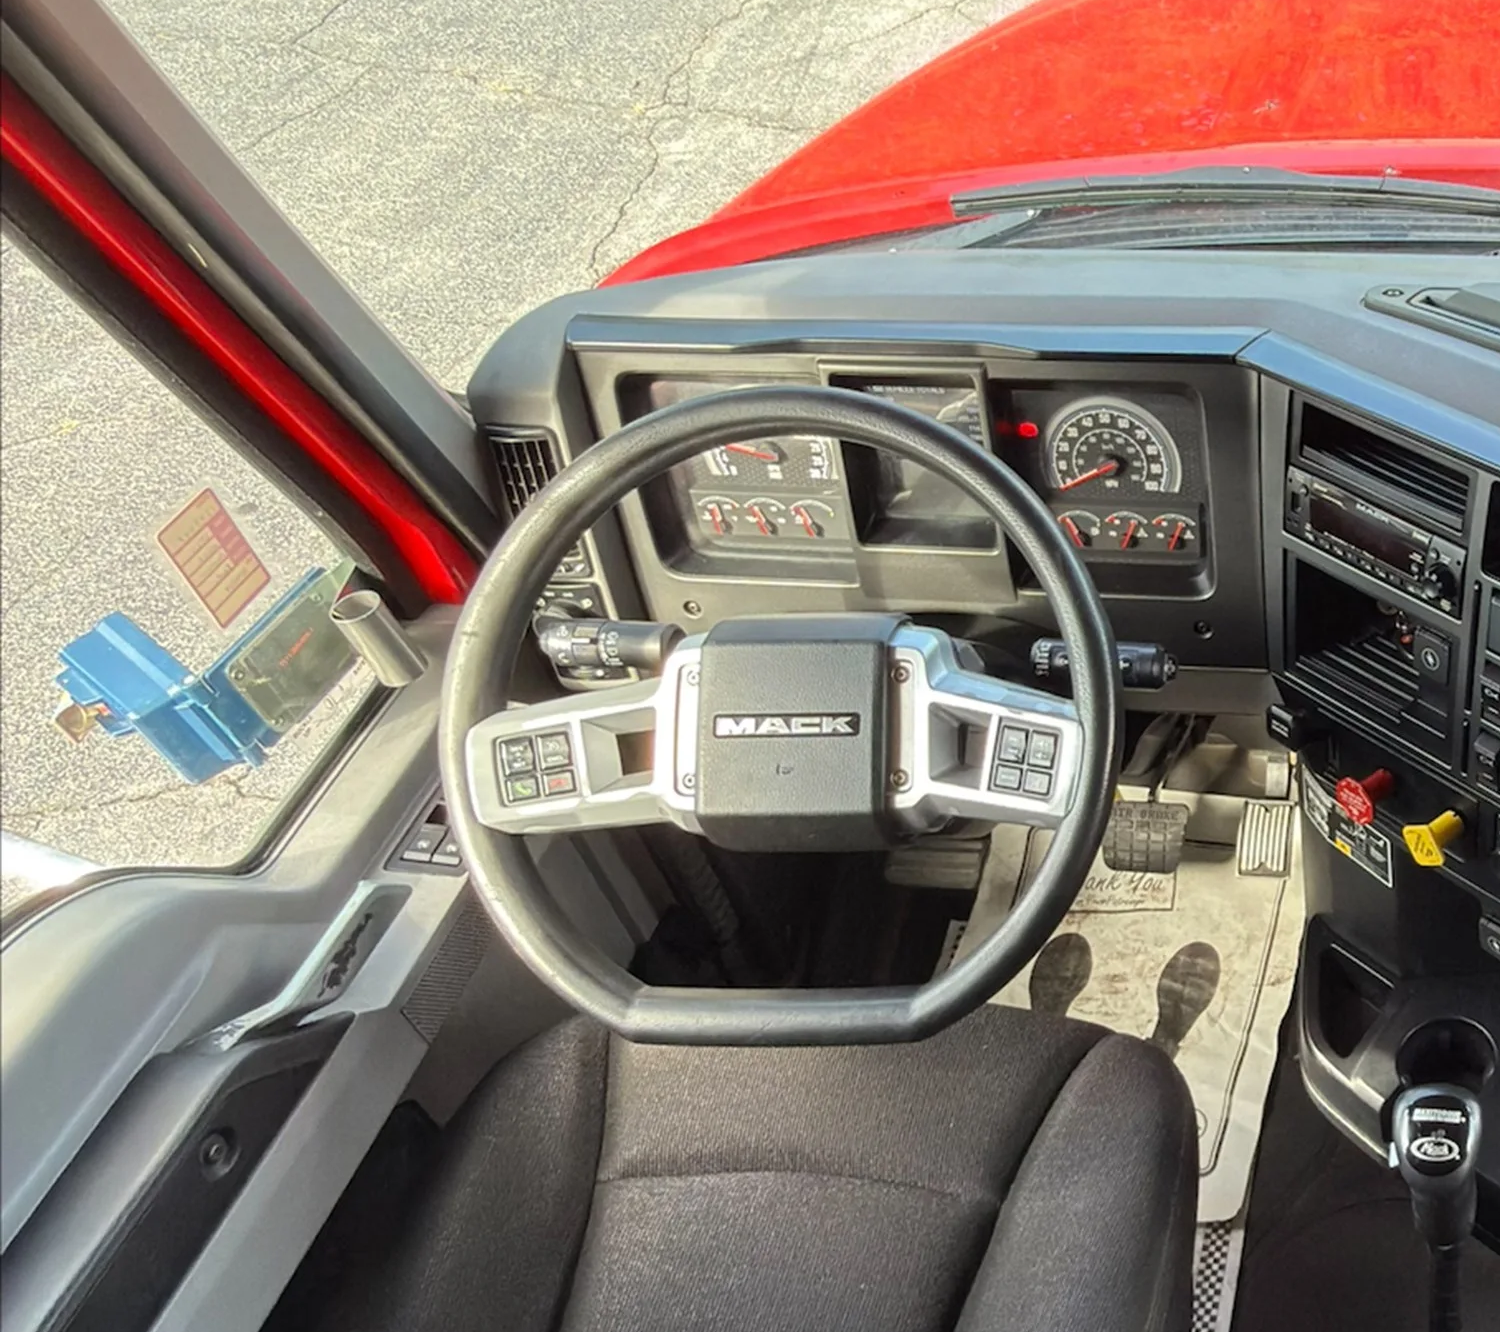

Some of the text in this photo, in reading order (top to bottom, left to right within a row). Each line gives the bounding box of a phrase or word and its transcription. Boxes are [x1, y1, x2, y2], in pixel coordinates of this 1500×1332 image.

[715, 716, 855, 736] MACK
[1139, 808, 1180, 821] BRAKE
[1128, 872, 1164, 894] You
